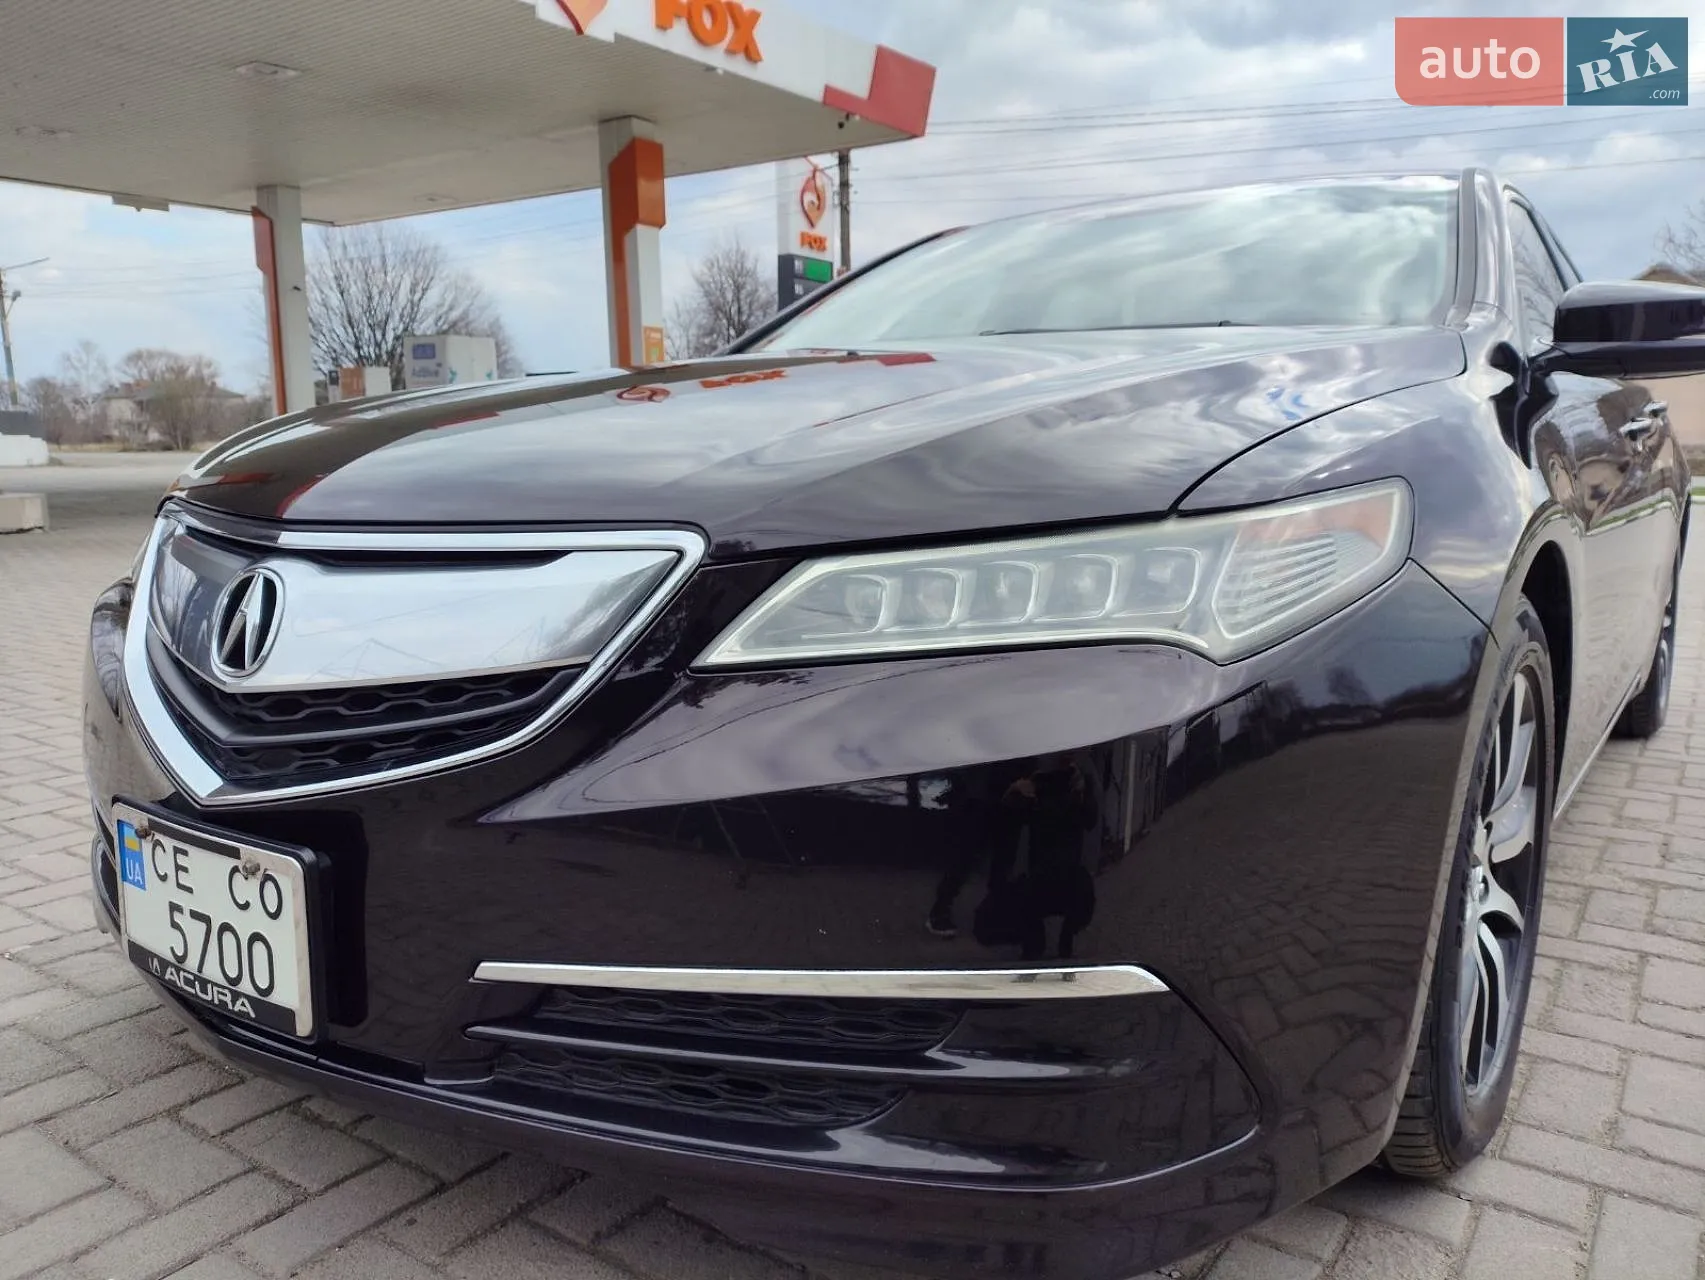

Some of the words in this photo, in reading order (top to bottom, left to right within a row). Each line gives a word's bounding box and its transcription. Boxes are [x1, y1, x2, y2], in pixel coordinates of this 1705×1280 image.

[800, 232, 827, 252] FOX
[125, 859, 143, 886] UA
[151, 838, 194, 894] CE
[228, 864, 283, 920] CO
[168, 900, 275, 997] 5700
[164, 966, 256, 1018] ACURA
